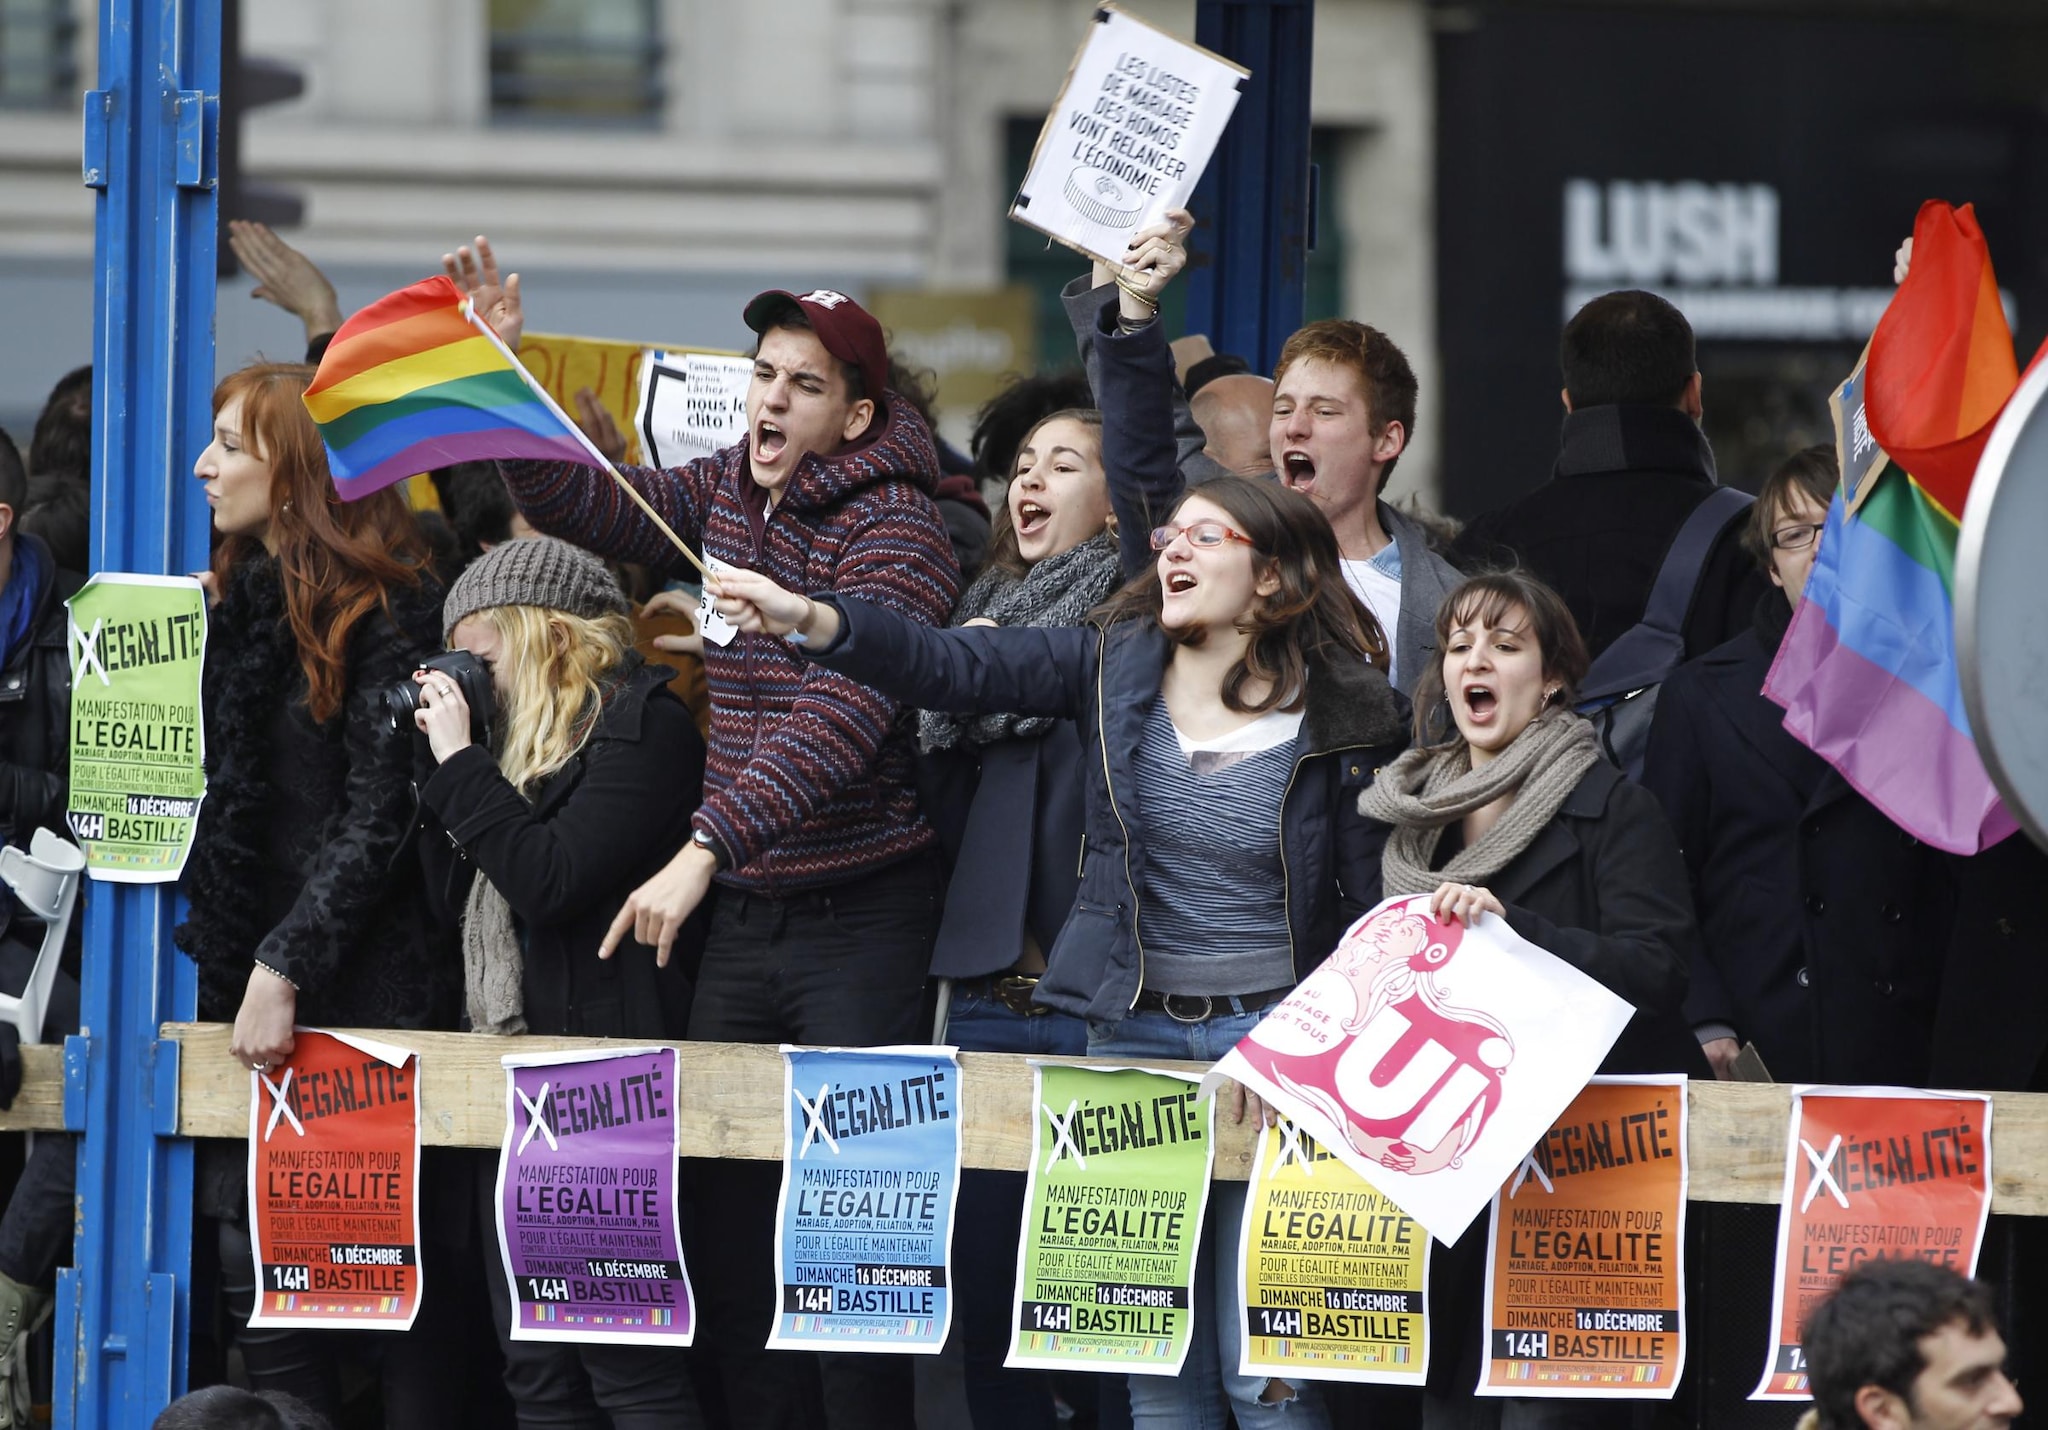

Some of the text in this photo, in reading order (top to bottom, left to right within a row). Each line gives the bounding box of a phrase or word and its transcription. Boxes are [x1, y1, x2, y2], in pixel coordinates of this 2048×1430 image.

[1115, 52, 1200, 104] LES LISTES
[1102, 73, 1194, 128] DE MARIAGE
[1093, 96, 1180, 150] DES HOMOS
[1069, 109, 1187, 181] VONT RELANCER
[1072, 140, 1161, 196] L'ÉCONOMIE
[1565, 179, 1780, 284] LUSH
[800, 290, 849, 310] H
[687, 398, 726, 410] nous
[687, 412, 722, 428] clito
[77, 699, 165, 721] MANIFESTATION
[72, 795, 193, 817] DIMANCHE 16 DÉCEMBRE
[72, 814, 187, 842] 14H BASTILLE
[1304, 990, 1321, 998] AU
[1294, 1018, 1328, 1043] TOUS
[269, 1151, 400, 1170] MANIFESTATION POUR
[518, 1165, 657, 1187] MANIFESTATION POUR
[803, 1169, 940, 1190] MANIFESTATION POUR
[268, 1200, 400, 1212] MARIAGE, ADOPTION, FILIATION, PMA
[1046, 1184, 1187, 1210] MANIFESTATION POUR
[1269, 1190, 1377, 1212] MANIFESTATION
[271, 1216, 401, 1232] POUR L'ÉGALITÉ MAINTENANT
[517, 1215, 659, 1228] MARIAGE, ADOPTION, FILIATION, PMA
[796, 1218, 933, 1231] MARIAGE, ADOPTION, FILIATION, PMA
[1513, 1209, 1663, 1230] MANIFESTATION POUR
[521, 1230, 662, 1248] POUR L'ÉGALITÉ MAINTENANT
[796, 1234, 933, 1253] POUR L'ÉGALITÉ MAINTENANT
[1040, 1235, 1179, 1252] MARIAGE, ADOPTION, FILIATION, PMA
[1805, 1223, 1962, 1246] MANIFESTATION POUR
[274, 1245, 403, 1265] DIMANCHE 16 DÉCEMBRE
[795, 1251, 931, 1263] CONTRE LES DISCRIMINATIONS TOUT LE TEMPS
[1261, 1240, 1409, 1255] MARIAGE, ADOPTION, FILIATION, PMA
[525, 1260, 668, 1279] DIMANCHE 16 DÉCEMBRE
[1039, 1252, 1177, 1273] POUR L'ÉGALITÉ MAINTENANT
[1261, 1257, 1409, 1277] POUR L'ÉGALITÉ MAINTENANT
[1509, 1261, 1662, 1274] MARIAGE, ADOPTION, FILIATION, PMA
[274, 1266, 405, 1291] 14H BASTILLE
[796, 1266, 932, 1286] DIMANCHE 16 DÉCEMBRE
[1037, 1268, 1175, 1284] CONTRE LES DISCRIMINATIONS TOUT LE TEMPS
[1260, 1273, 1407, 1288] CONTRE LES DISCRIMINATIONS TOUT LE TEMPS
[529, 1278, 675, 1303] 14H BASTILLE
[1036, 1284, 1173, 1307] DIMANCHE 16 DÉCEMBRE
[1509, 1278, 1663, 1296] POUR L'ÉGALITÉ MAINTENANT
[796, 1288, 933, 1314] 14H BASTILLE
[1261, 1289, 1408, 1312] DIMANCHE 16 DÉCEMBRE
[1034, 1305, 1174, 1335] 14H BASTILLE
[1261, 1311, 1409, 1340] 14H BASTILLE
[1508, 1310, 1663, 1331] DIMANCHE 16 DÉCEMBRE
[1506, 1333, 1664, 1359] 14H BASTILLE
